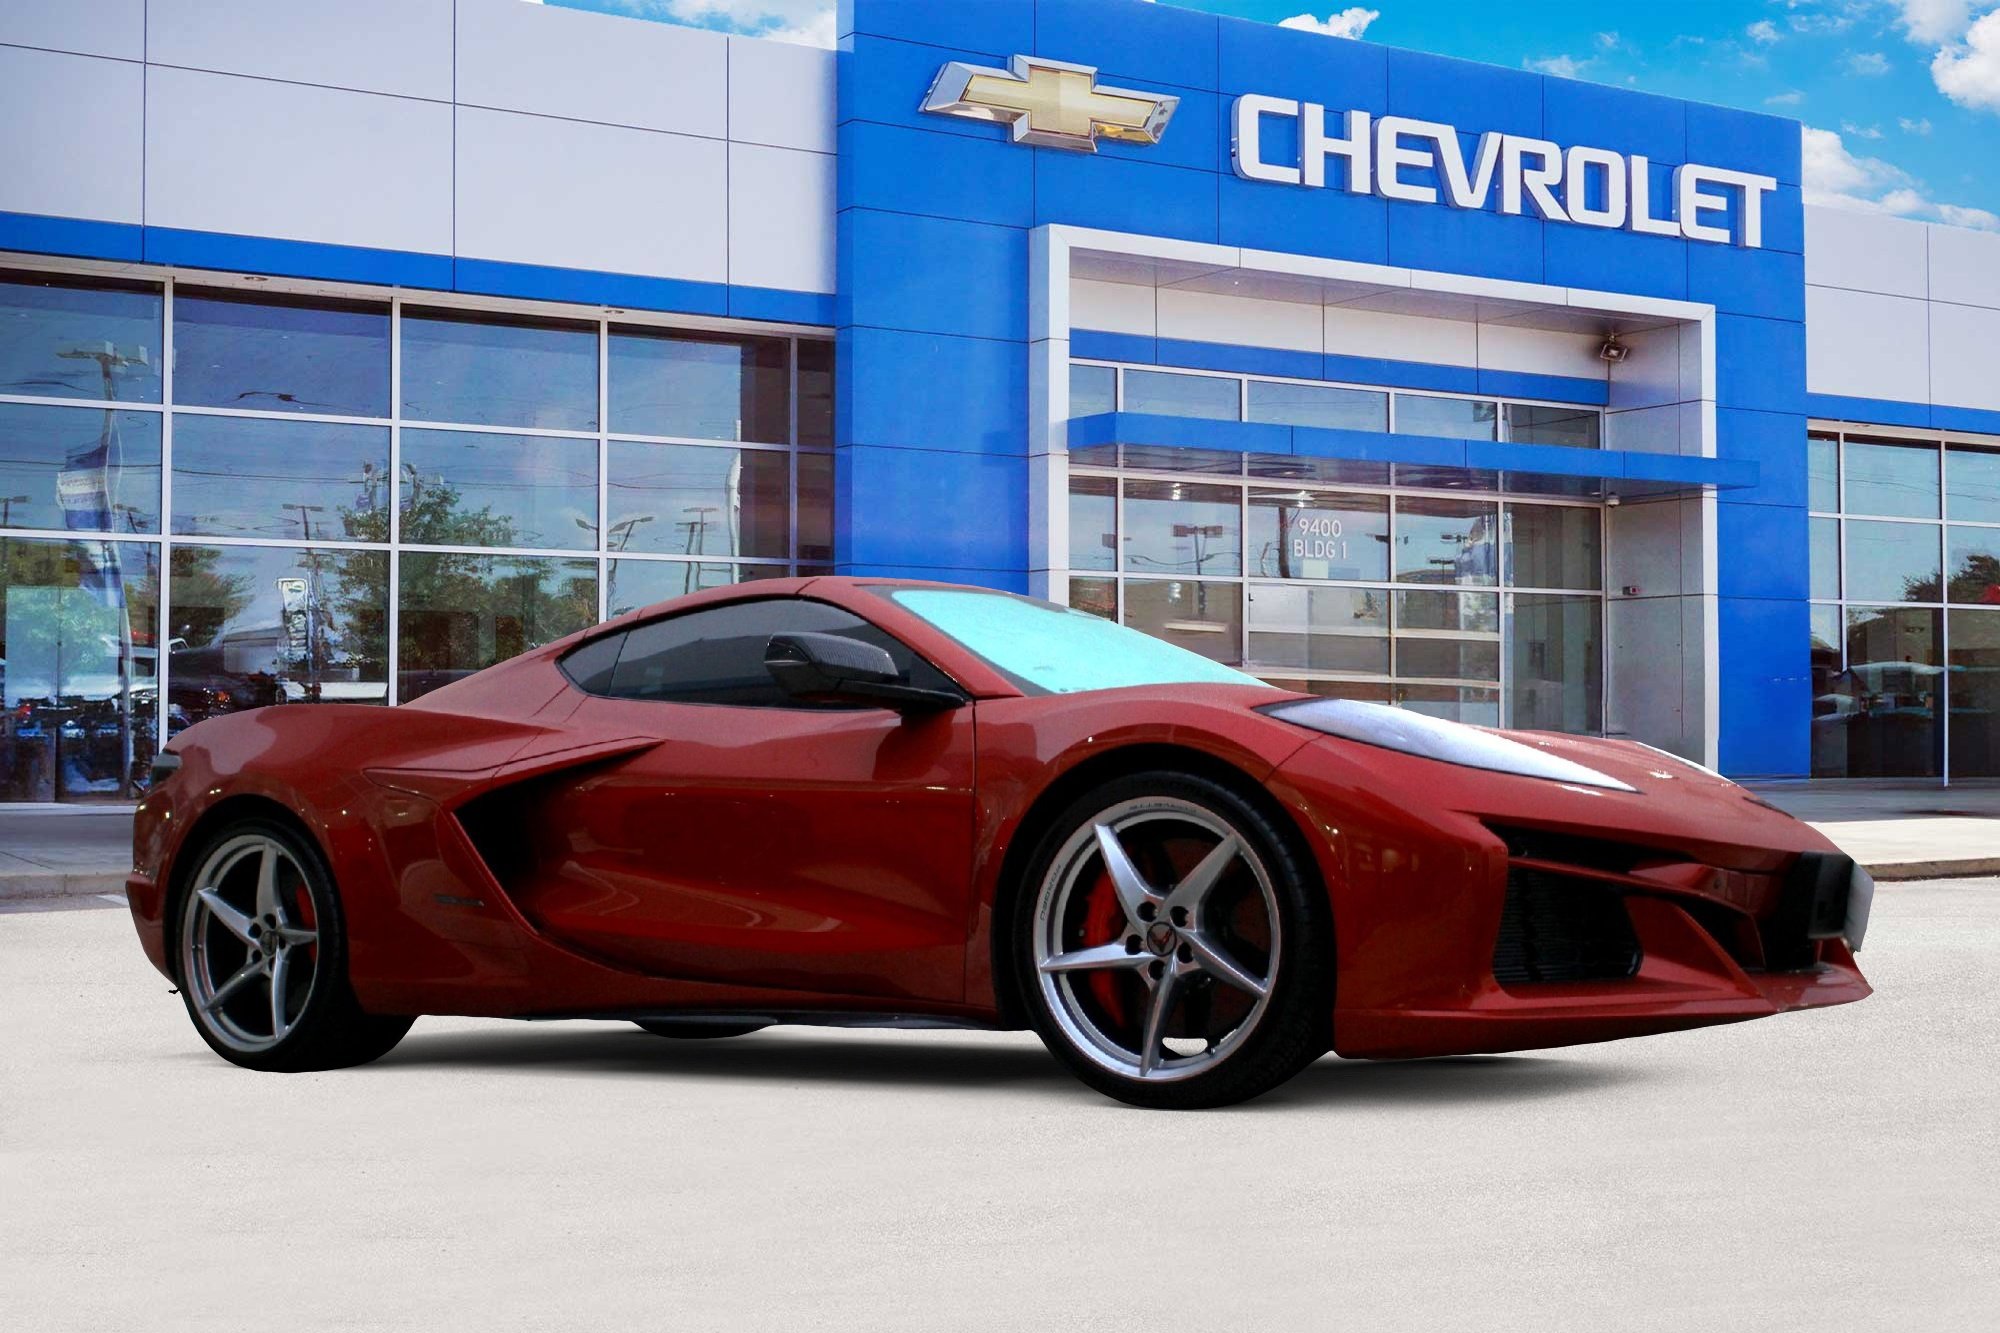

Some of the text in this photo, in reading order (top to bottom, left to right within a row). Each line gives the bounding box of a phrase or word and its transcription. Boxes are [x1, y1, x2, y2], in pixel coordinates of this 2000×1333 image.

[1231, 93, 1777, 248] CHEVROLET
[1299, 517, 1341, 538] 9400
[1294, 539, 1335, 558] BLDG
